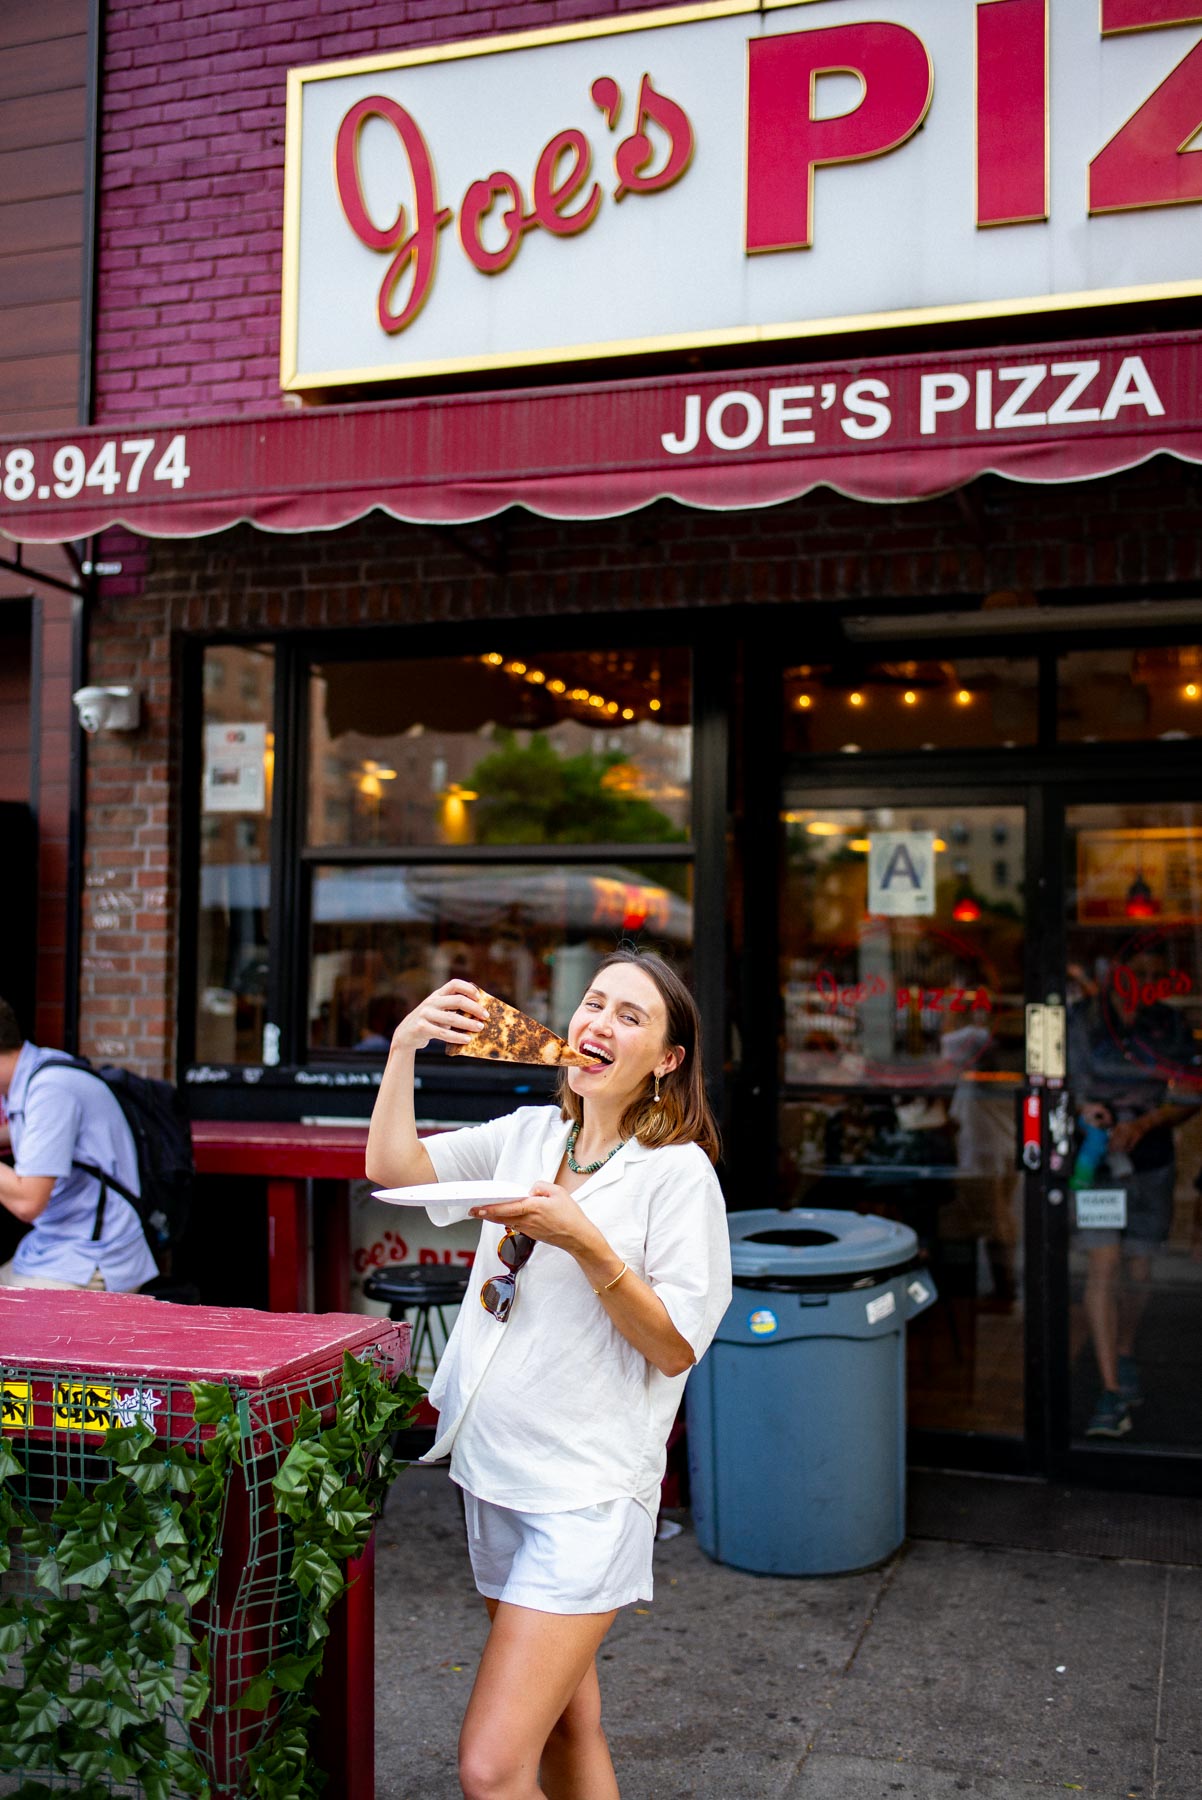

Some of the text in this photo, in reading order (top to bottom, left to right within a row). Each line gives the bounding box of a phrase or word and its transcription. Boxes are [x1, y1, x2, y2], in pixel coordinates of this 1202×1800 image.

[333, 72, 695, 336] Joe's
[661, 355, 1166, 455] JOE'S PIZZA
[0, 434, 191, 502] 8.9474
[879, 843, 922, 890] A
[815, 969, 993, 1016] Joe's PIZZA
[1113, 964, 1192, 1015] Joe's
[353, 1230, 408, 1274] oe's
